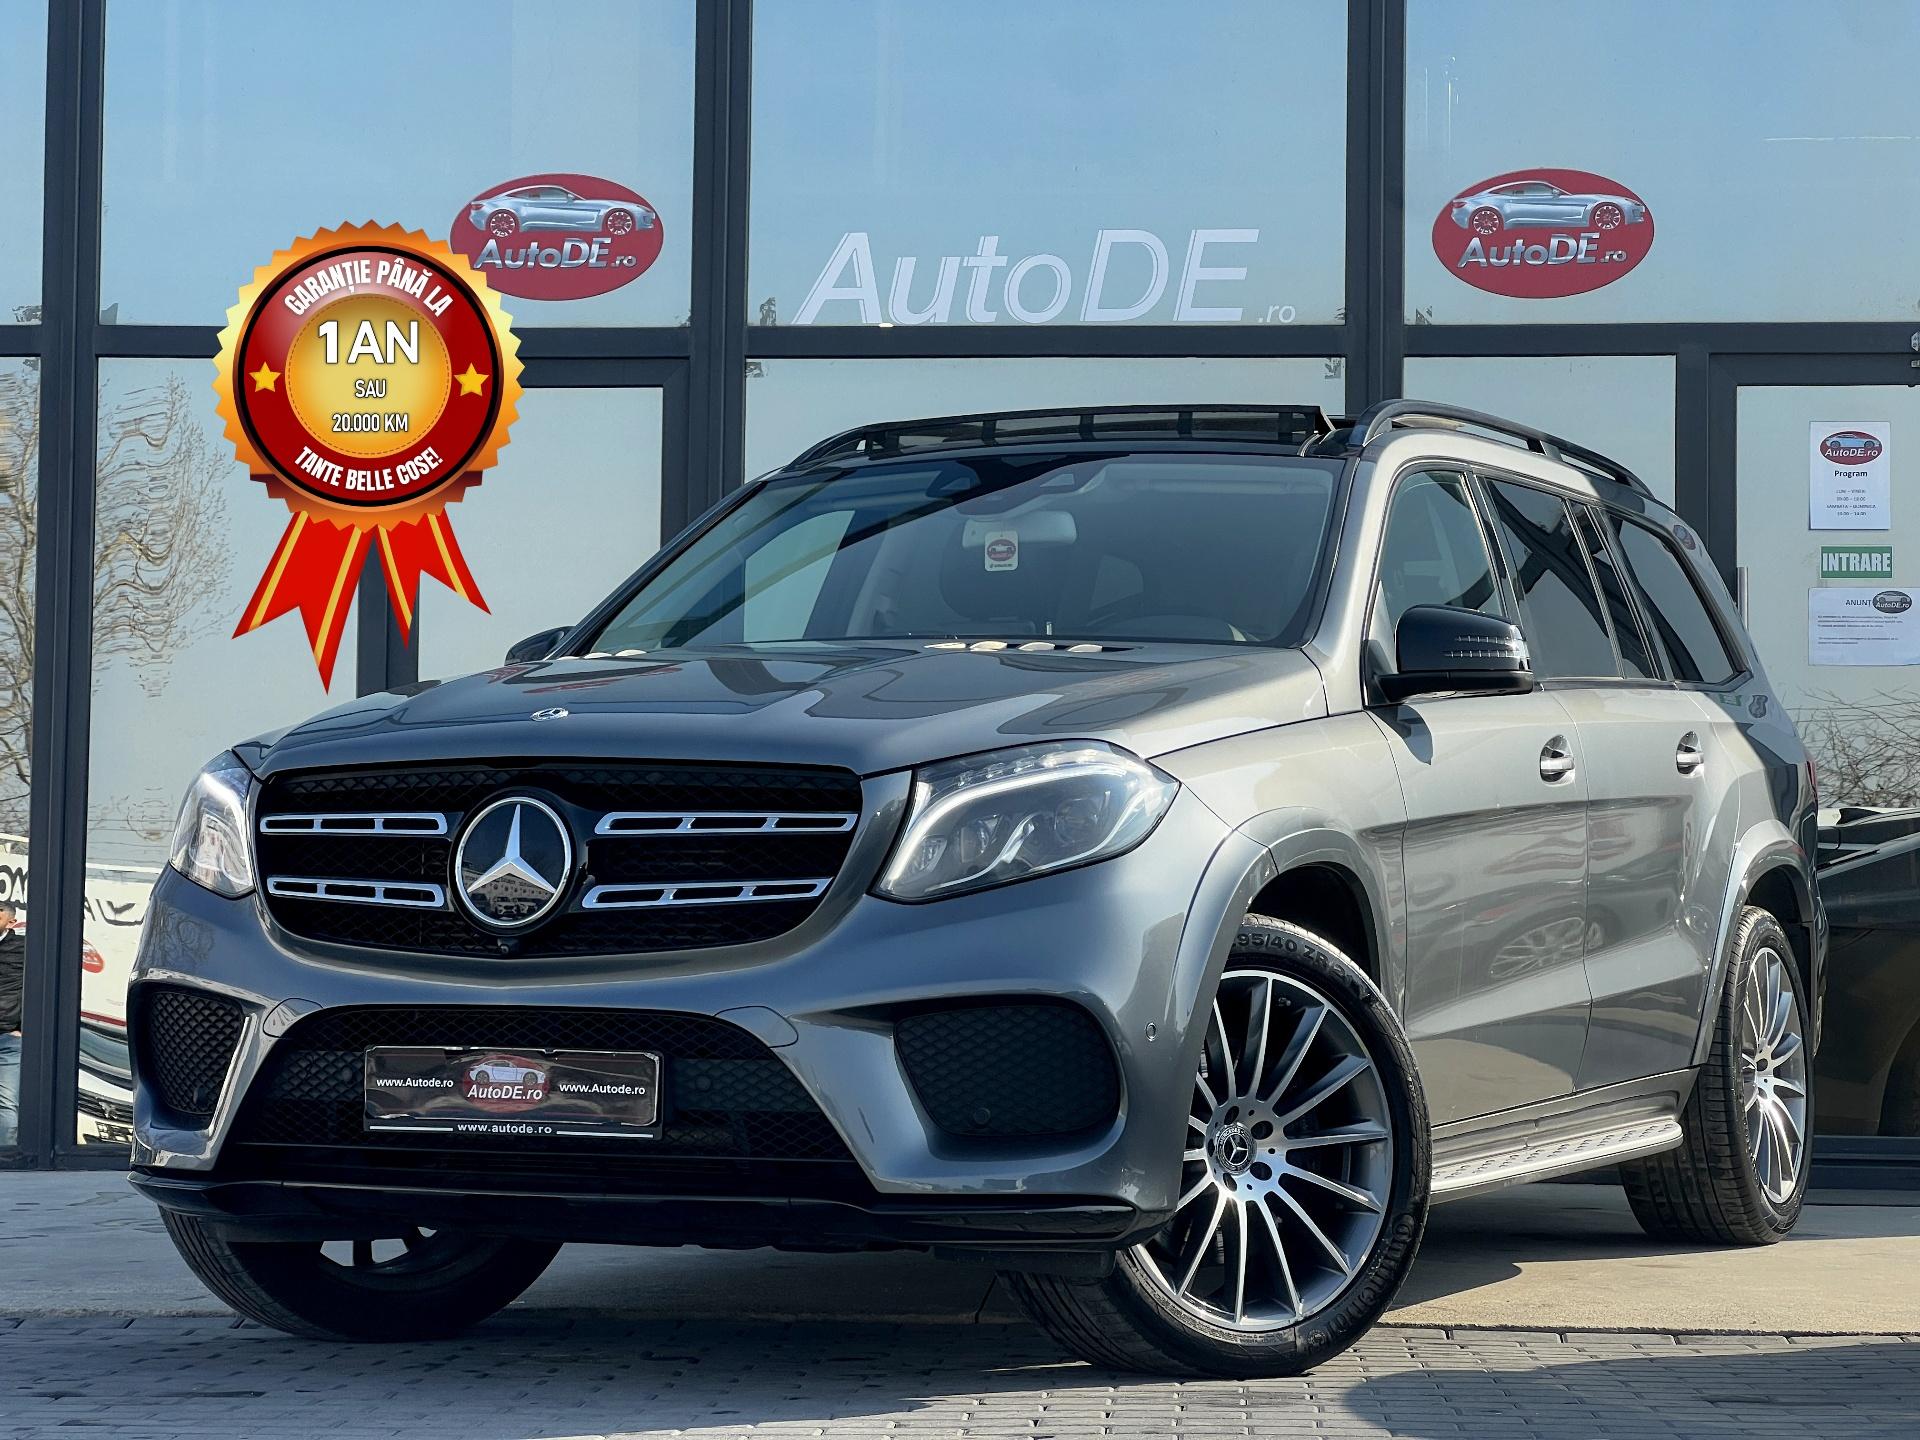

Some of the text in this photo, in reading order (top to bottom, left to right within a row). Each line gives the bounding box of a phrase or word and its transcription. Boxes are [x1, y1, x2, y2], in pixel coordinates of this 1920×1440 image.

[1824, 448, 1879, 458] AutoDE.ro
[1834, 470, 1868, 479] Program
[1822, 552, 1891, 572] INTRARE
[1232, 932, 1298, 953] 95/40
[376, 1076, 454, 1088] www.Autode.ro
[467, 1084, 543, 1101] AutoDE.ro
[558, 1082, 646, 1096] www.Autode.ro
[457, 1122, 553, 1135] www.autode.ro
